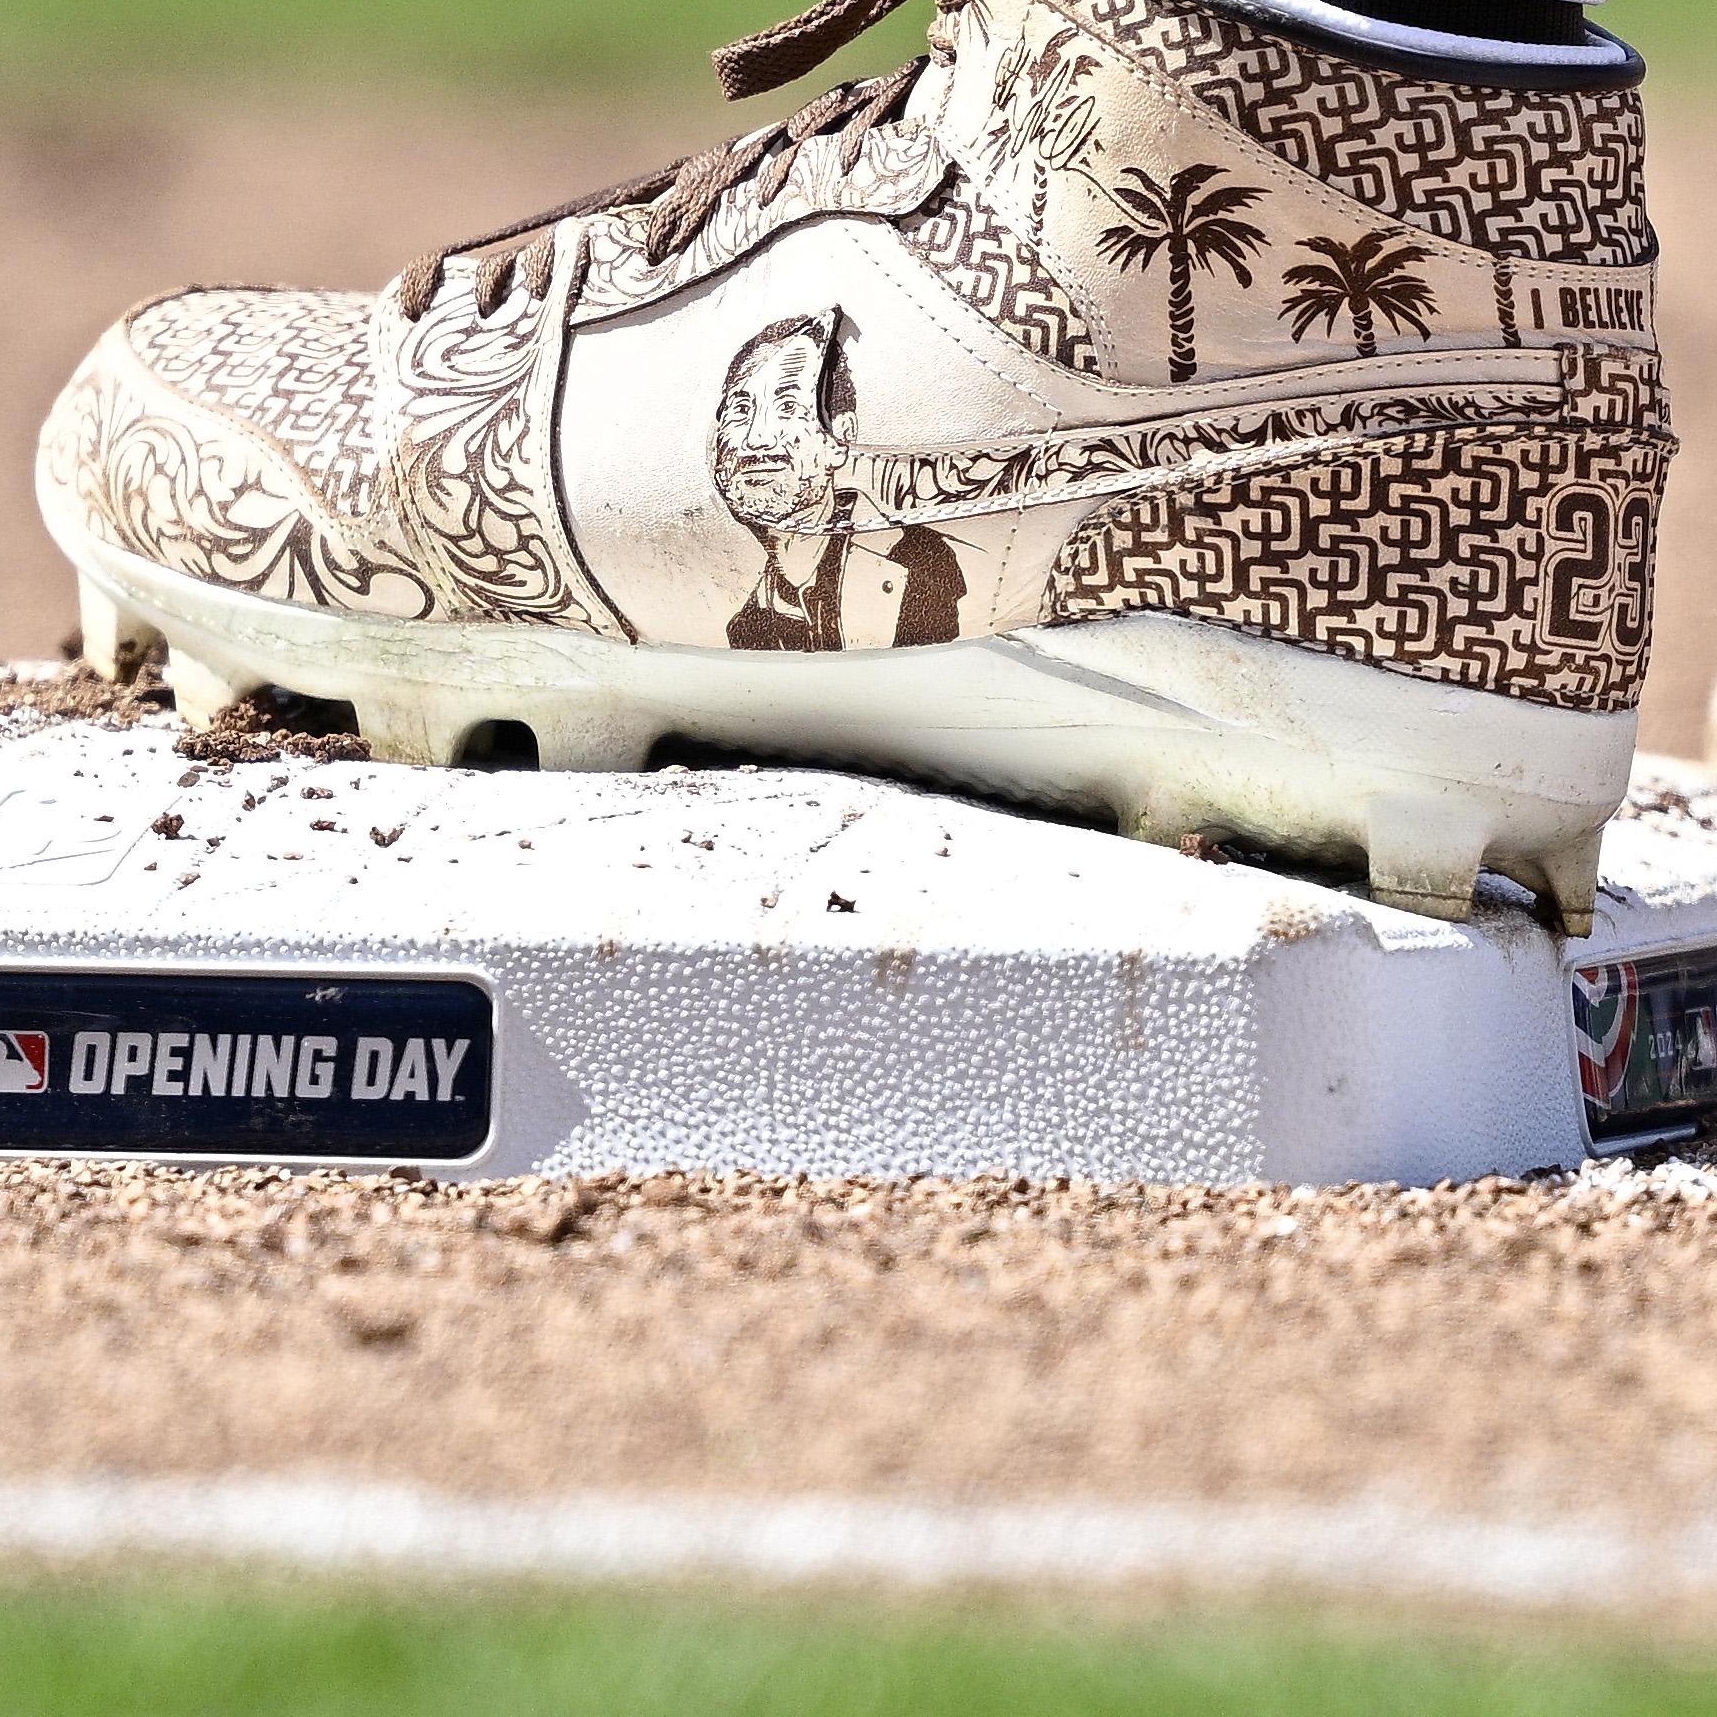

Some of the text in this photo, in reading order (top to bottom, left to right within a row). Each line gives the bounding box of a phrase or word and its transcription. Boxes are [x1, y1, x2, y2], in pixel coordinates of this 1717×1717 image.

[1530, 286, 1645, 332] I BELIEVE
[1540, 482, 1652, 657] 23
[69, 1031, 339, 1099] OPENING
[350, 1036, 471, 1102] DAY
[1648, 1030, 1683, 1059] 2024
